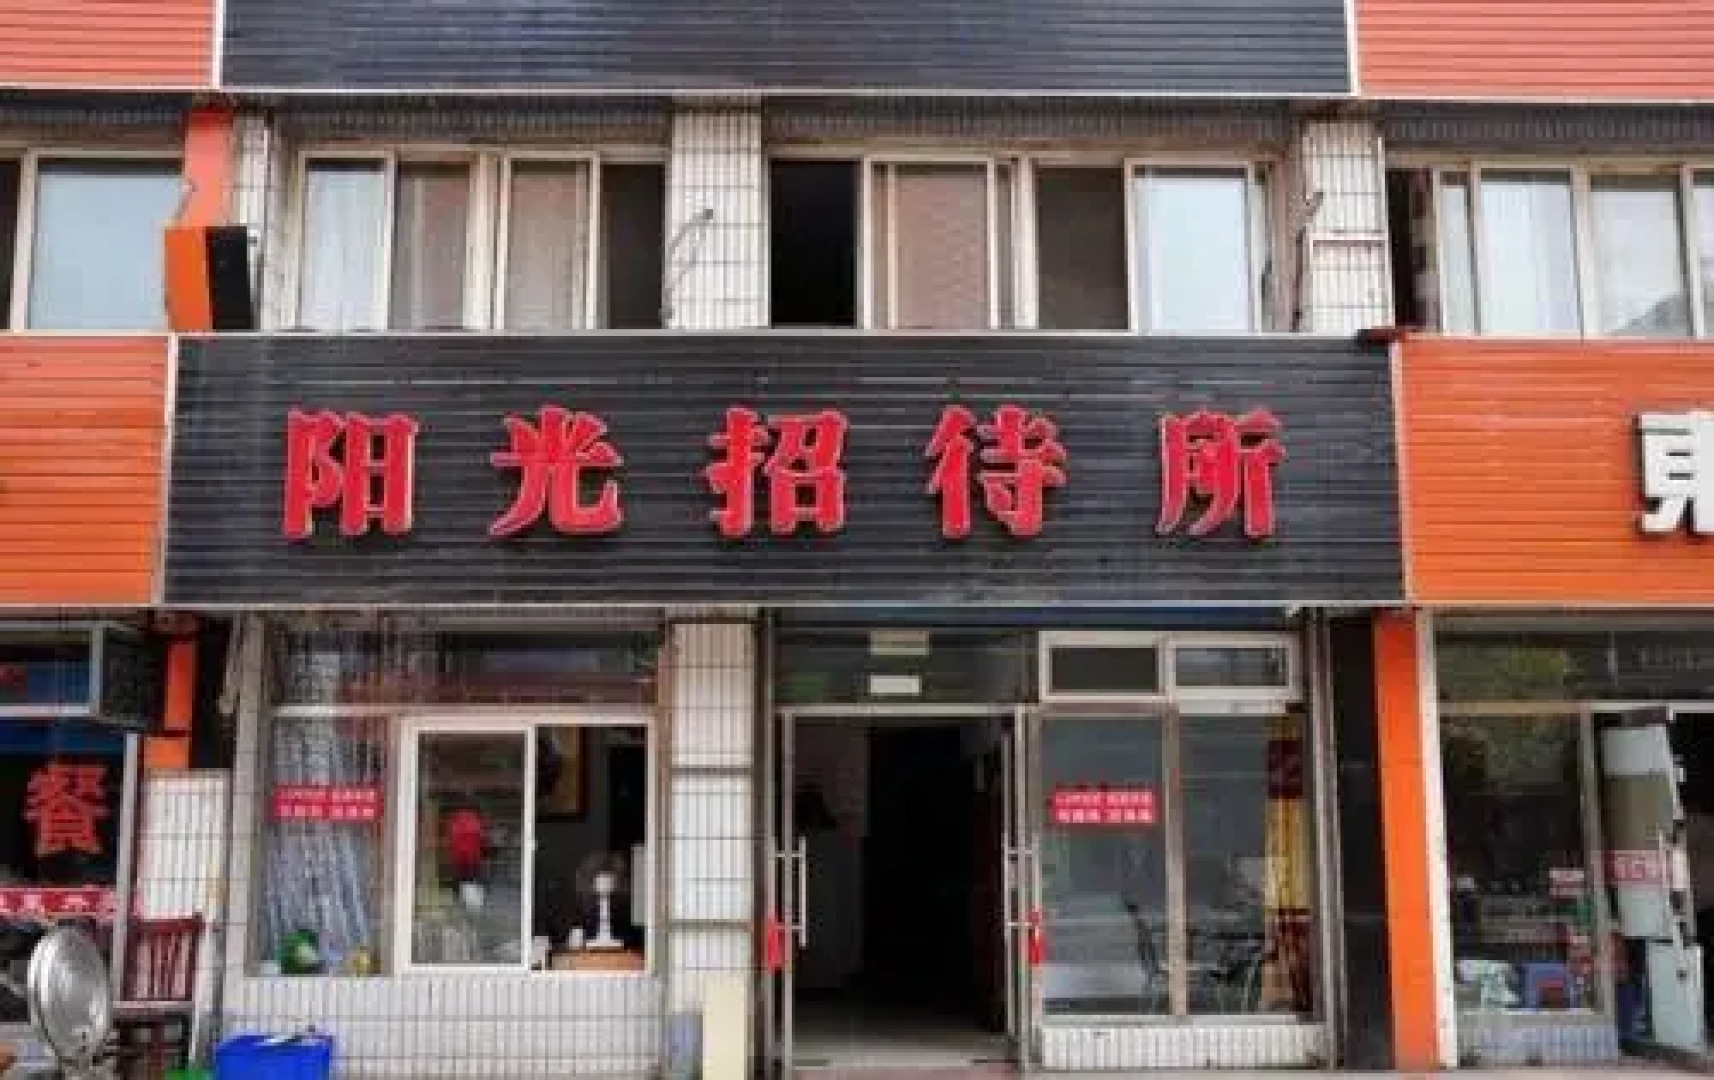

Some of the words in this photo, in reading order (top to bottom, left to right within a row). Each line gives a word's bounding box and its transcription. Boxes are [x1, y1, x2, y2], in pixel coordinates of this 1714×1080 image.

[283, 405, 1287, 538] 阳光招待所
[24, 763, 110, 857] 餐
